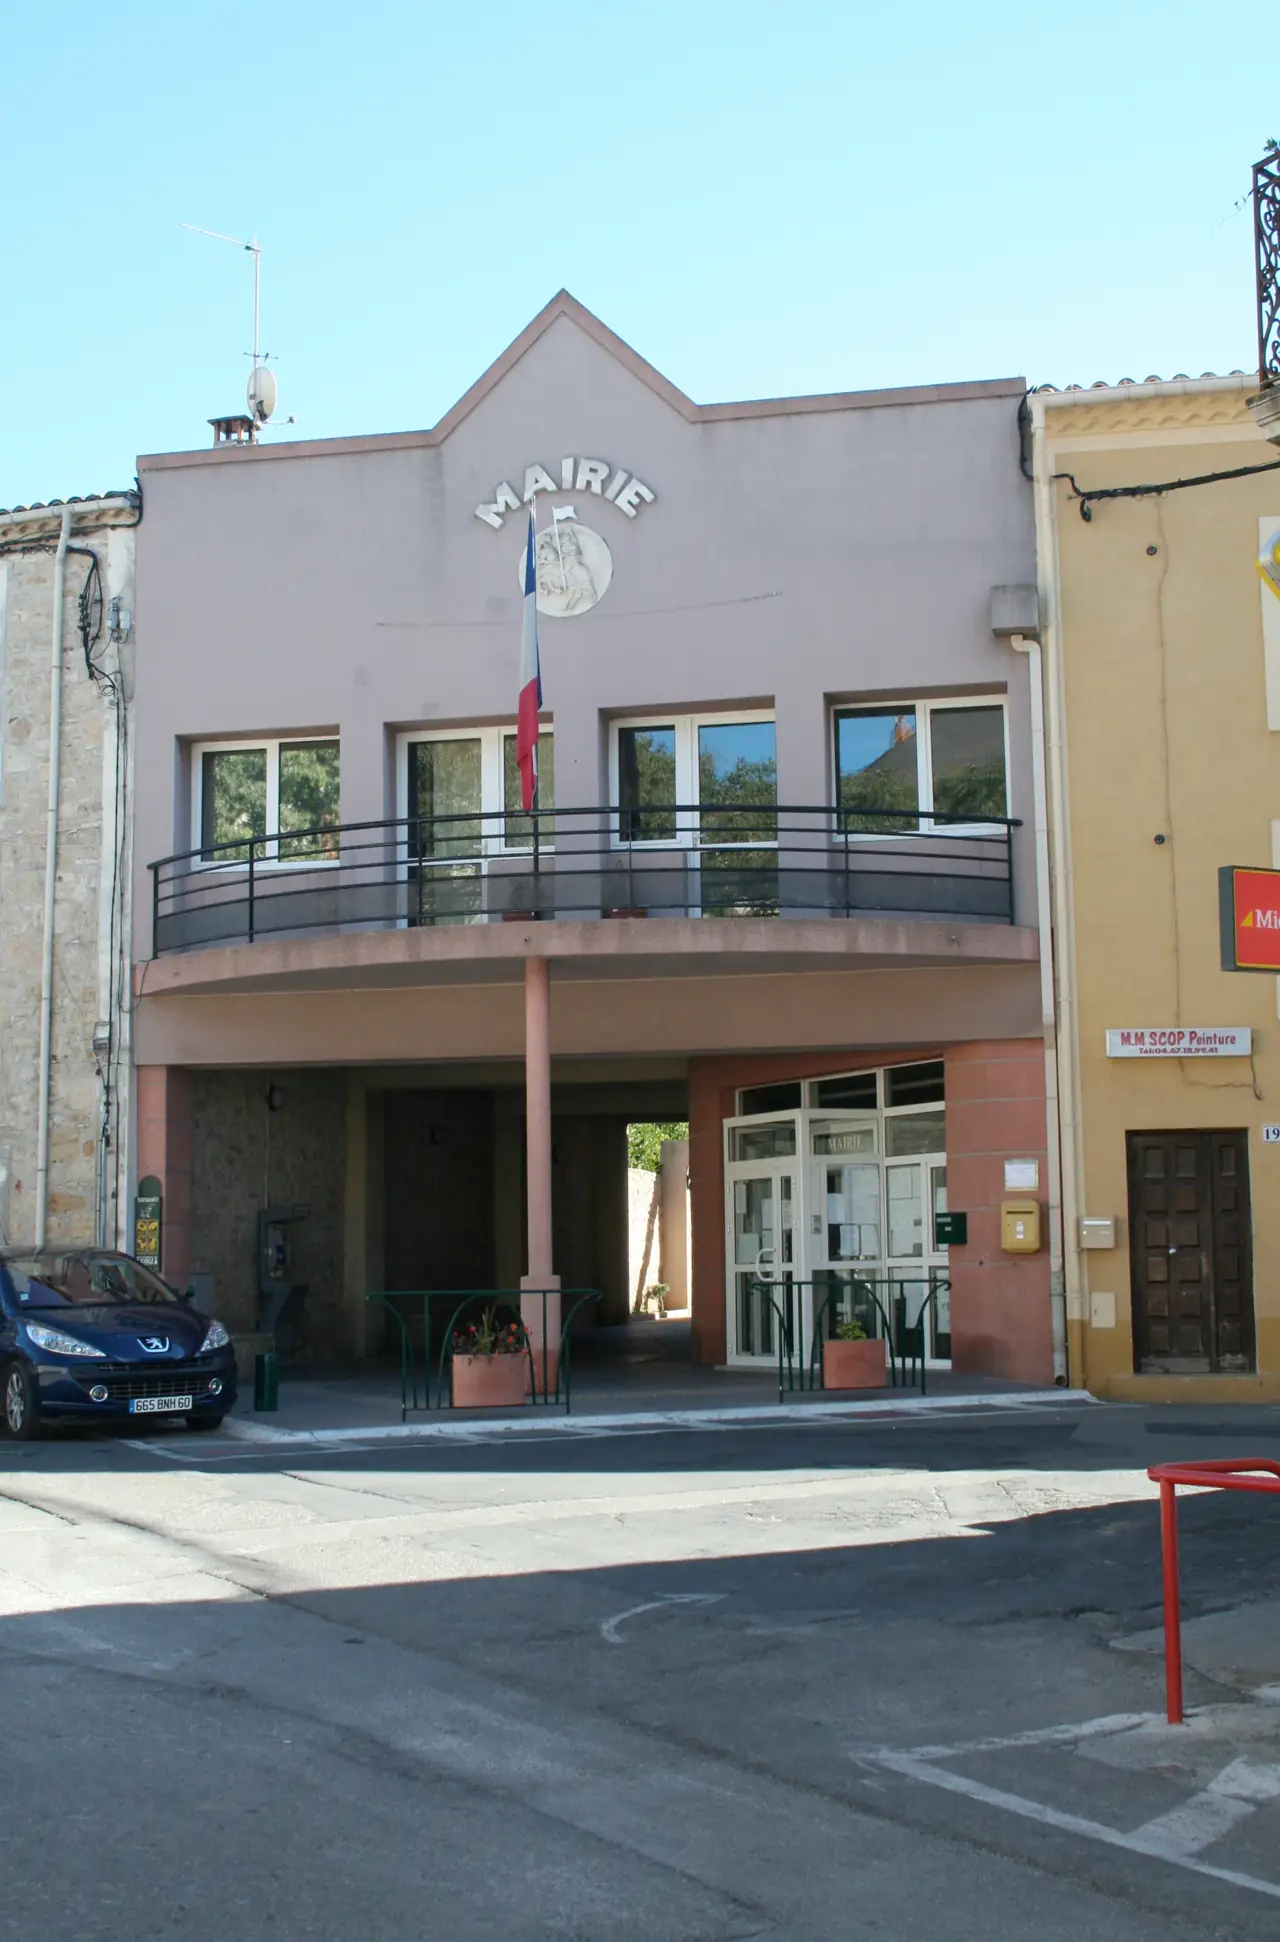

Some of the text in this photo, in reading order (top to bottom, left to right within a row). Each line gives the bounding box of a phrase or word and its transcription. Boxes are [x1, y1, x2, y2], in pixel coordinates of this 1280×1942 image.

[473, 457, 657, 530] MAIRIE
[1254, 908, 1280, 929] Mi
[1149, 1031, 1185, 1046] SCOP
[1189, 1030, 1236, 1045] Peinture
[1265, 1127, 1280, 1140] 19
[136, 1396, 190, 1412] 665 BNH 60
